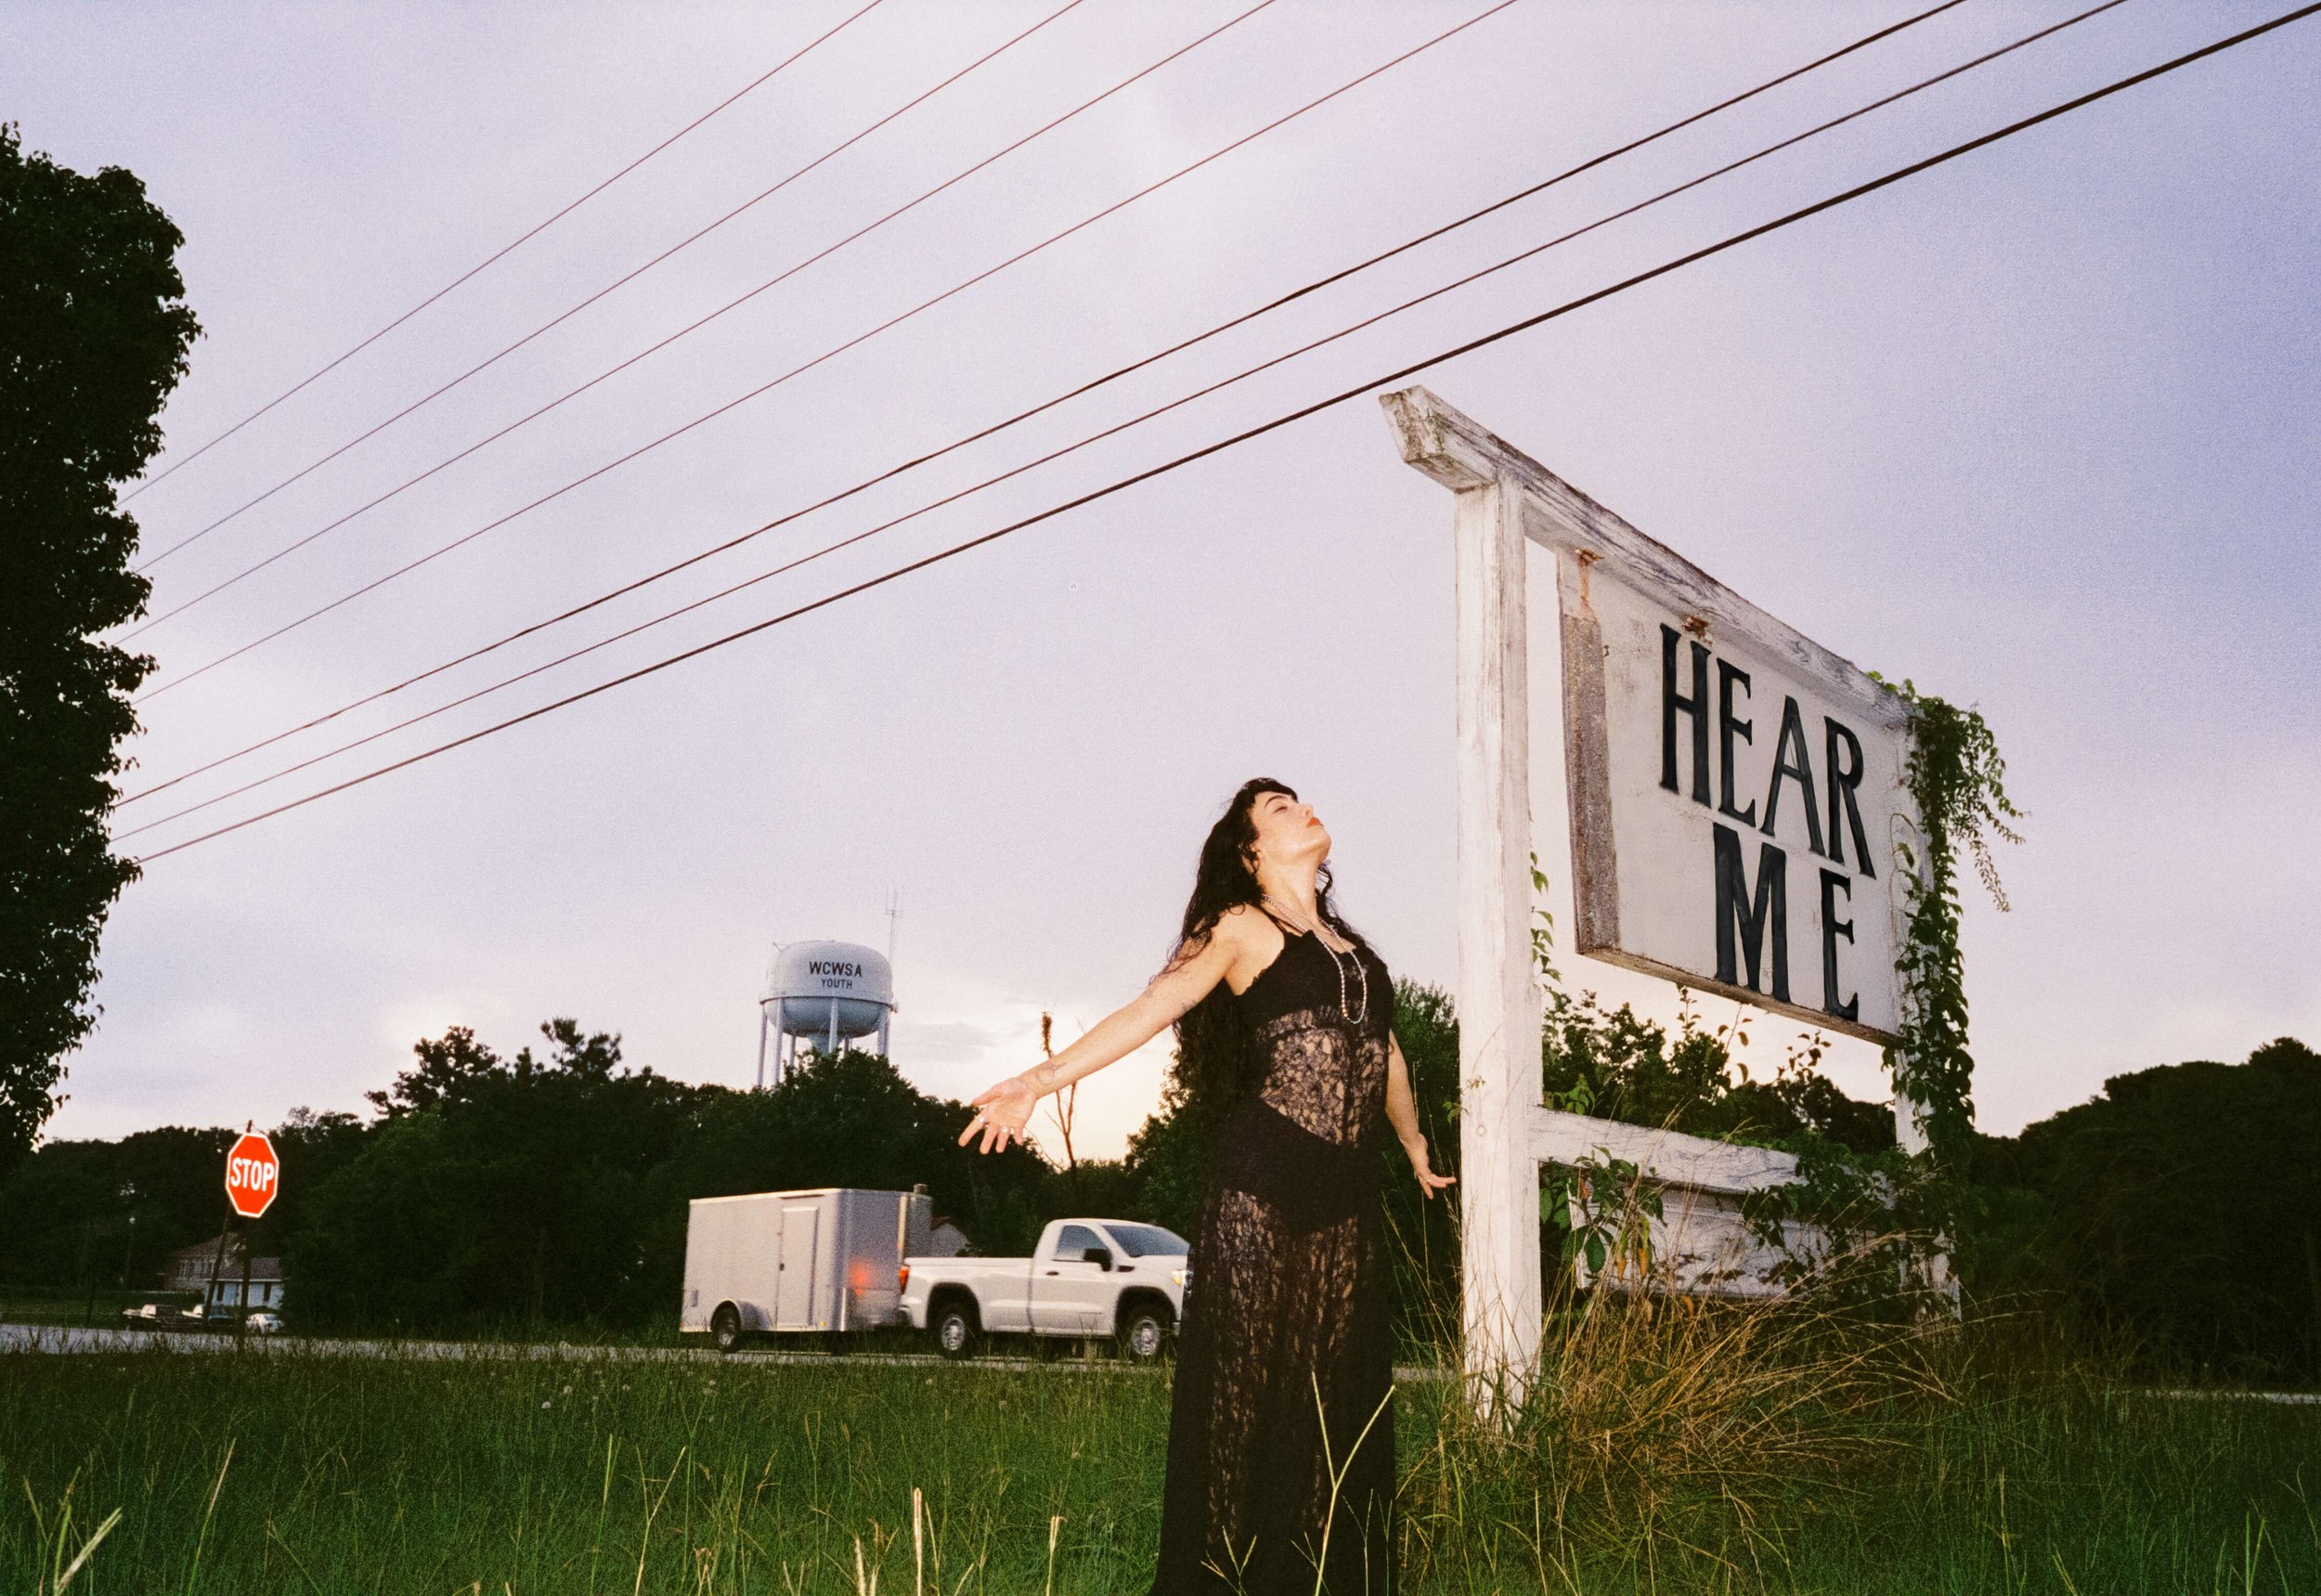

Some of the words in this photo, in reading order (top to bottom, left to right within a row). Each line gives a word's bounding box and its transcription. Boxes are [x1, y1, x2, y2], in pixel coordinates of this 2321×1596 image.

[1658, 622, 1876, 880] HEAR
[1712, 822, 1859, 1022] ME
[809, 961, 862, 978] WCWSA
[821, 978, 853, 990] YOUTH
[230, 1157, 275, 1192] STOP
